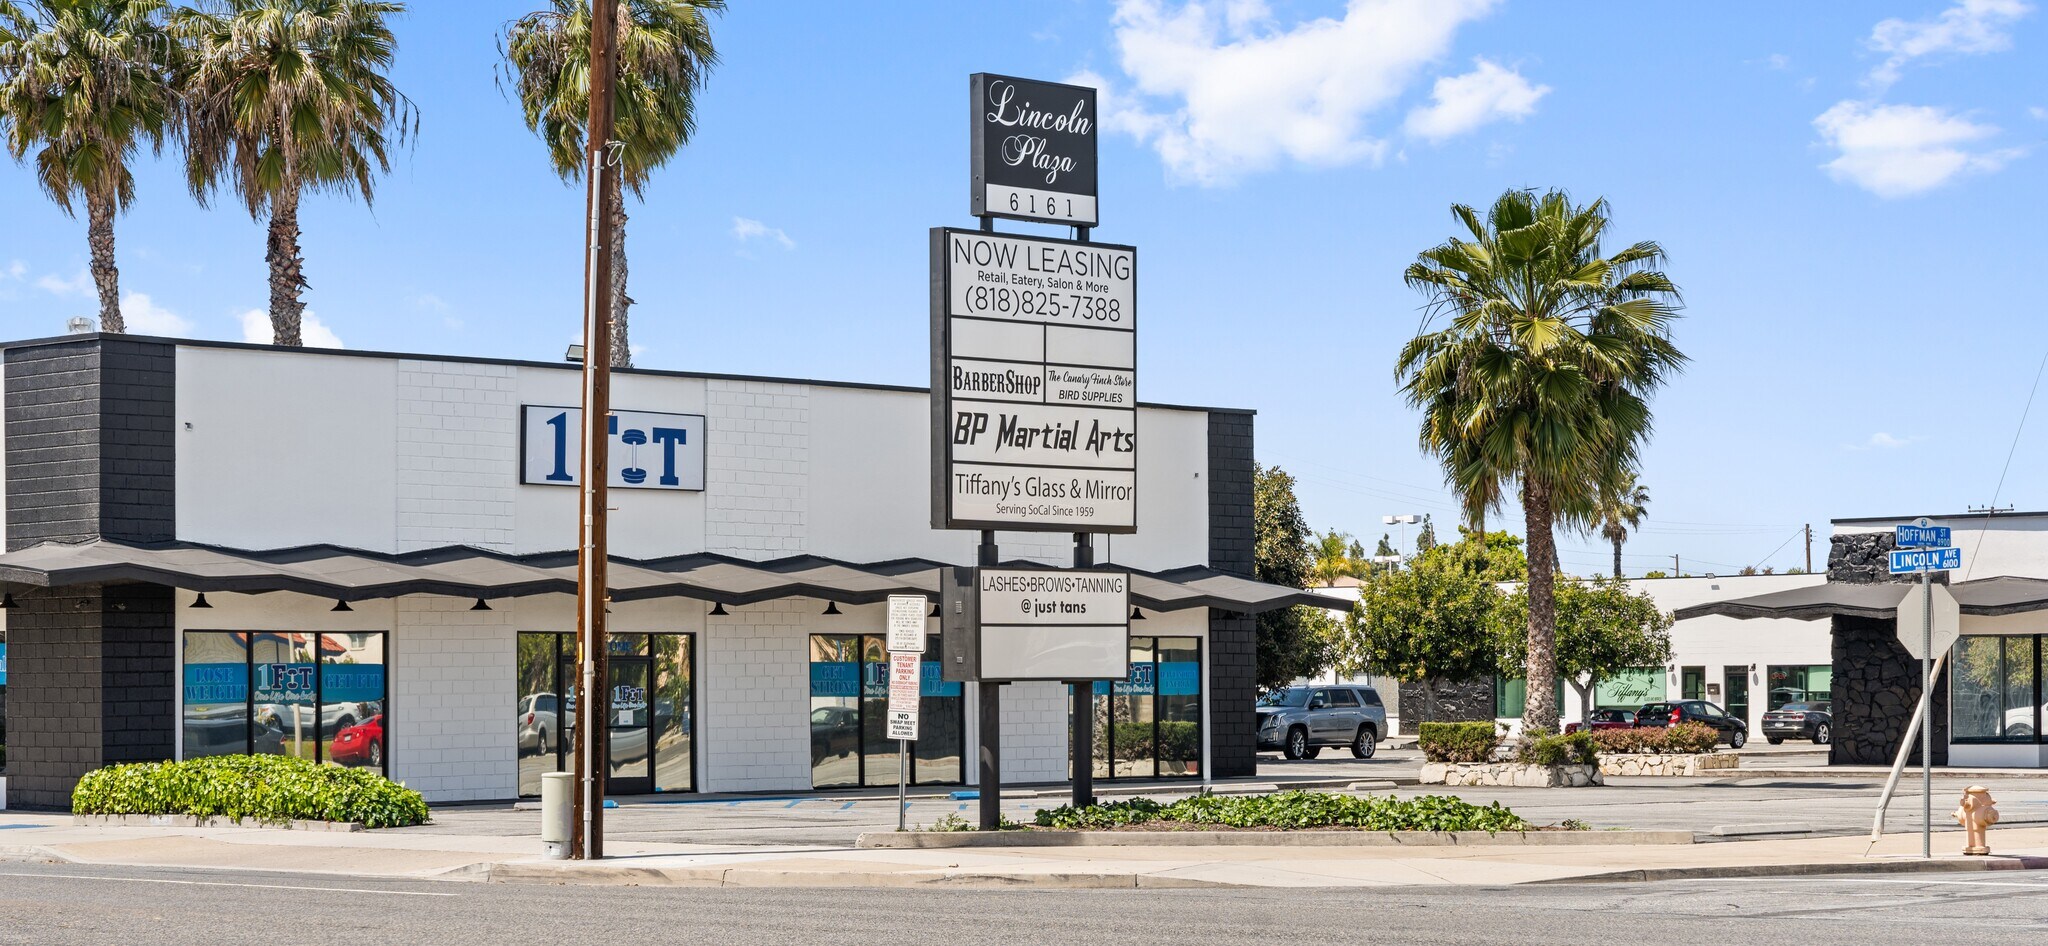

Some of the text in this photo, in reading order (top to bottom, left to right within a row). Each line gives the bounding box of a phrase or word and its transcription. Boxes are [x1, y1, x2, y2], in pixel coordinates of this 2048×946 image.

[987, 80, 1093, 135] Lincoln
[1002, 134, 1077, 184] Plaza
[955, 238, 1130, 280] NOW LEASING
[977, 270, 1109, 293] Retail, Eatery, Salon & More
[965, 285, 1121, 322] (818)825-7388
[1048, 370, 1132, 389] The Canary Finch Store
[1058, 390, 1123, 403] BIRD SUPPLIES
[953, 411, 1134, 458] BP Martial Arts
[955, 473, 1133, 501] Tiffany's Glass & Mirror
[996, 503, 1095, 517] Serving SoCal Since 1959
[1898, 527, 1946, 542] HOFFMAN ST
[1893, 552, 1939, 569] LINCOLN
[1944, 550, 1957, 558] AVE
[1943, 559, 1959, 568] 6100
[1021, 598, 1087, 617] @ just tans
[194, 667, 234, 683] LOSE
[324, 673, 382, 689] GET FIT
[821, 665, 845, 680] GET
[185, 684, 248, 700] WEIGHT
[811, 680, 859, 695] STRONG
[928, 680, 945, 693] UP
[1606, 681, 1650, 703] Tiffany's
